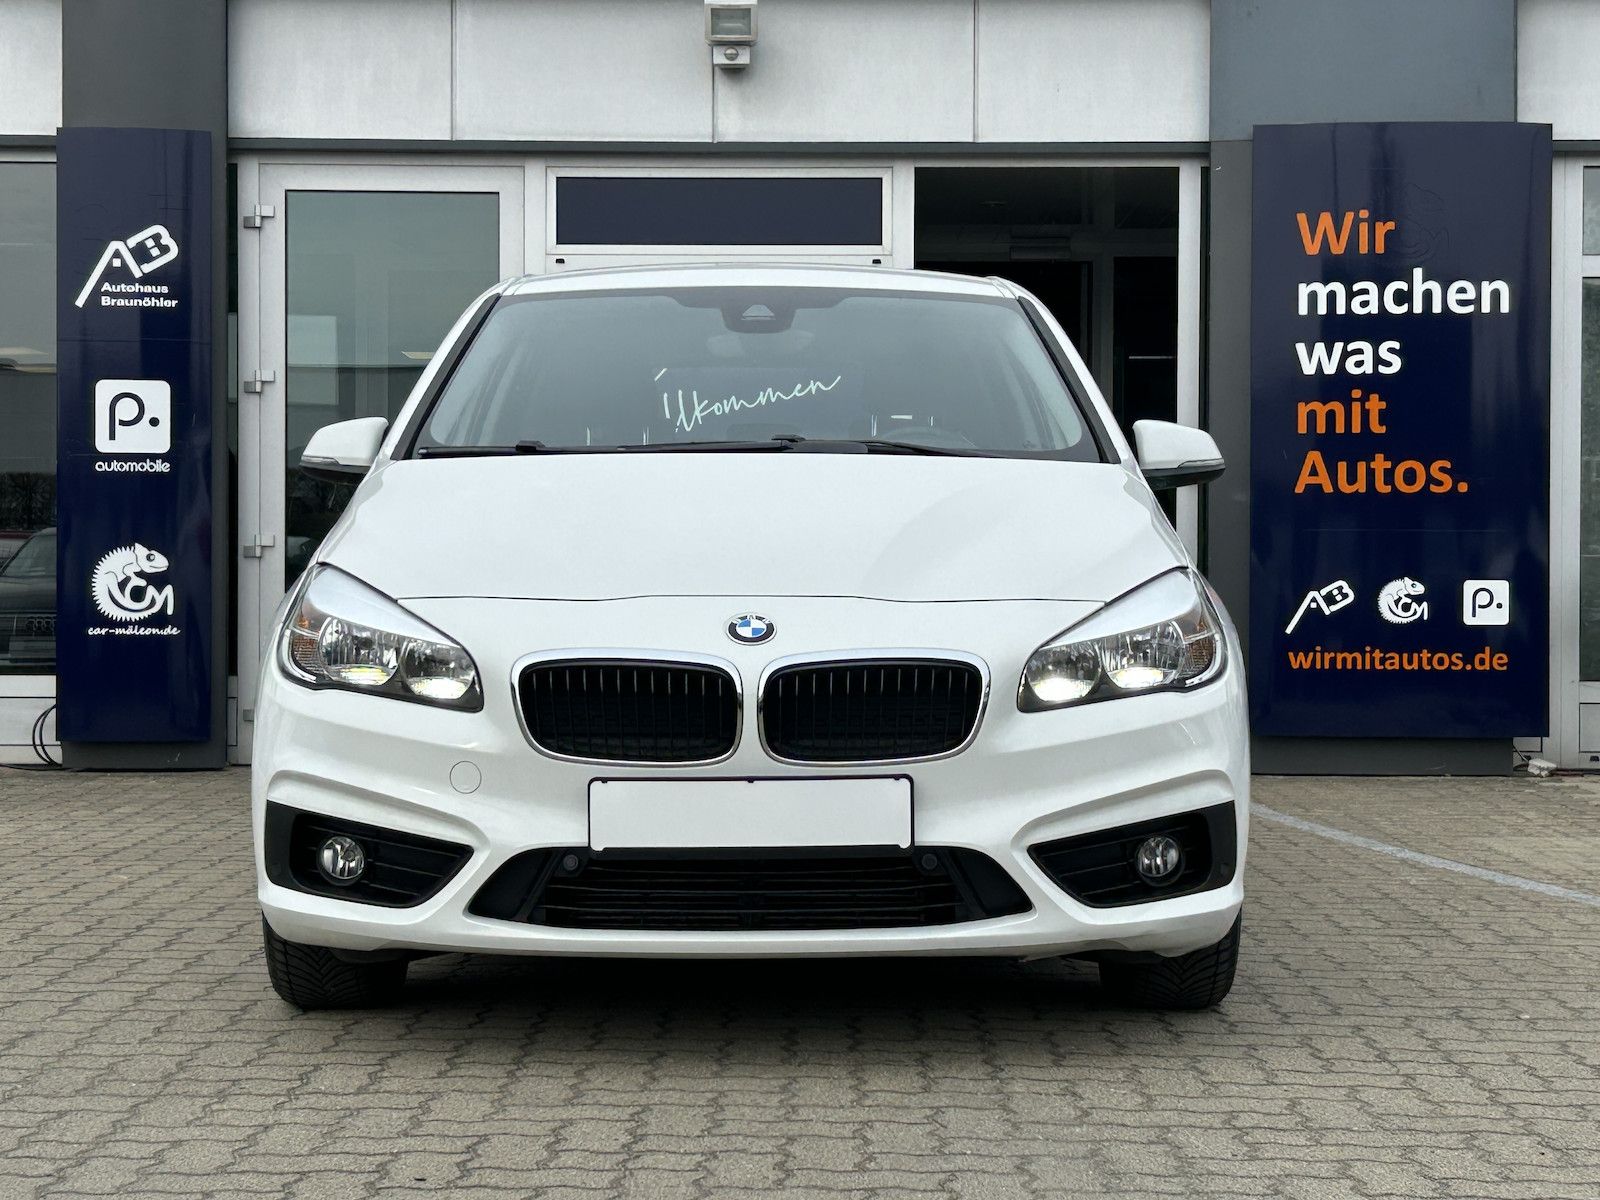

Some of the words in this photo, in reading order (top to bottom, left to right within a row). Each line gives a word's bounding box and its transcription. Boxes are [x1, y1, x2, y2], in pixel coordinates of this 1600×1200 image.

[1296, 209, 1396, 256] Wir
[100, 281, 169, 294] Autohaus
[101, 295, 178, 308] Braunöhler
[1298, 267, 1510, 316] machen
[1295, 340, 1402, 375] was
[1297, 389, 1387, 434] mit
[95, 458, 171, 473] automobile
[1294, 450, 1468, 493] Autos.
[1288, 646, 1508, 670] wirmitautos.de
